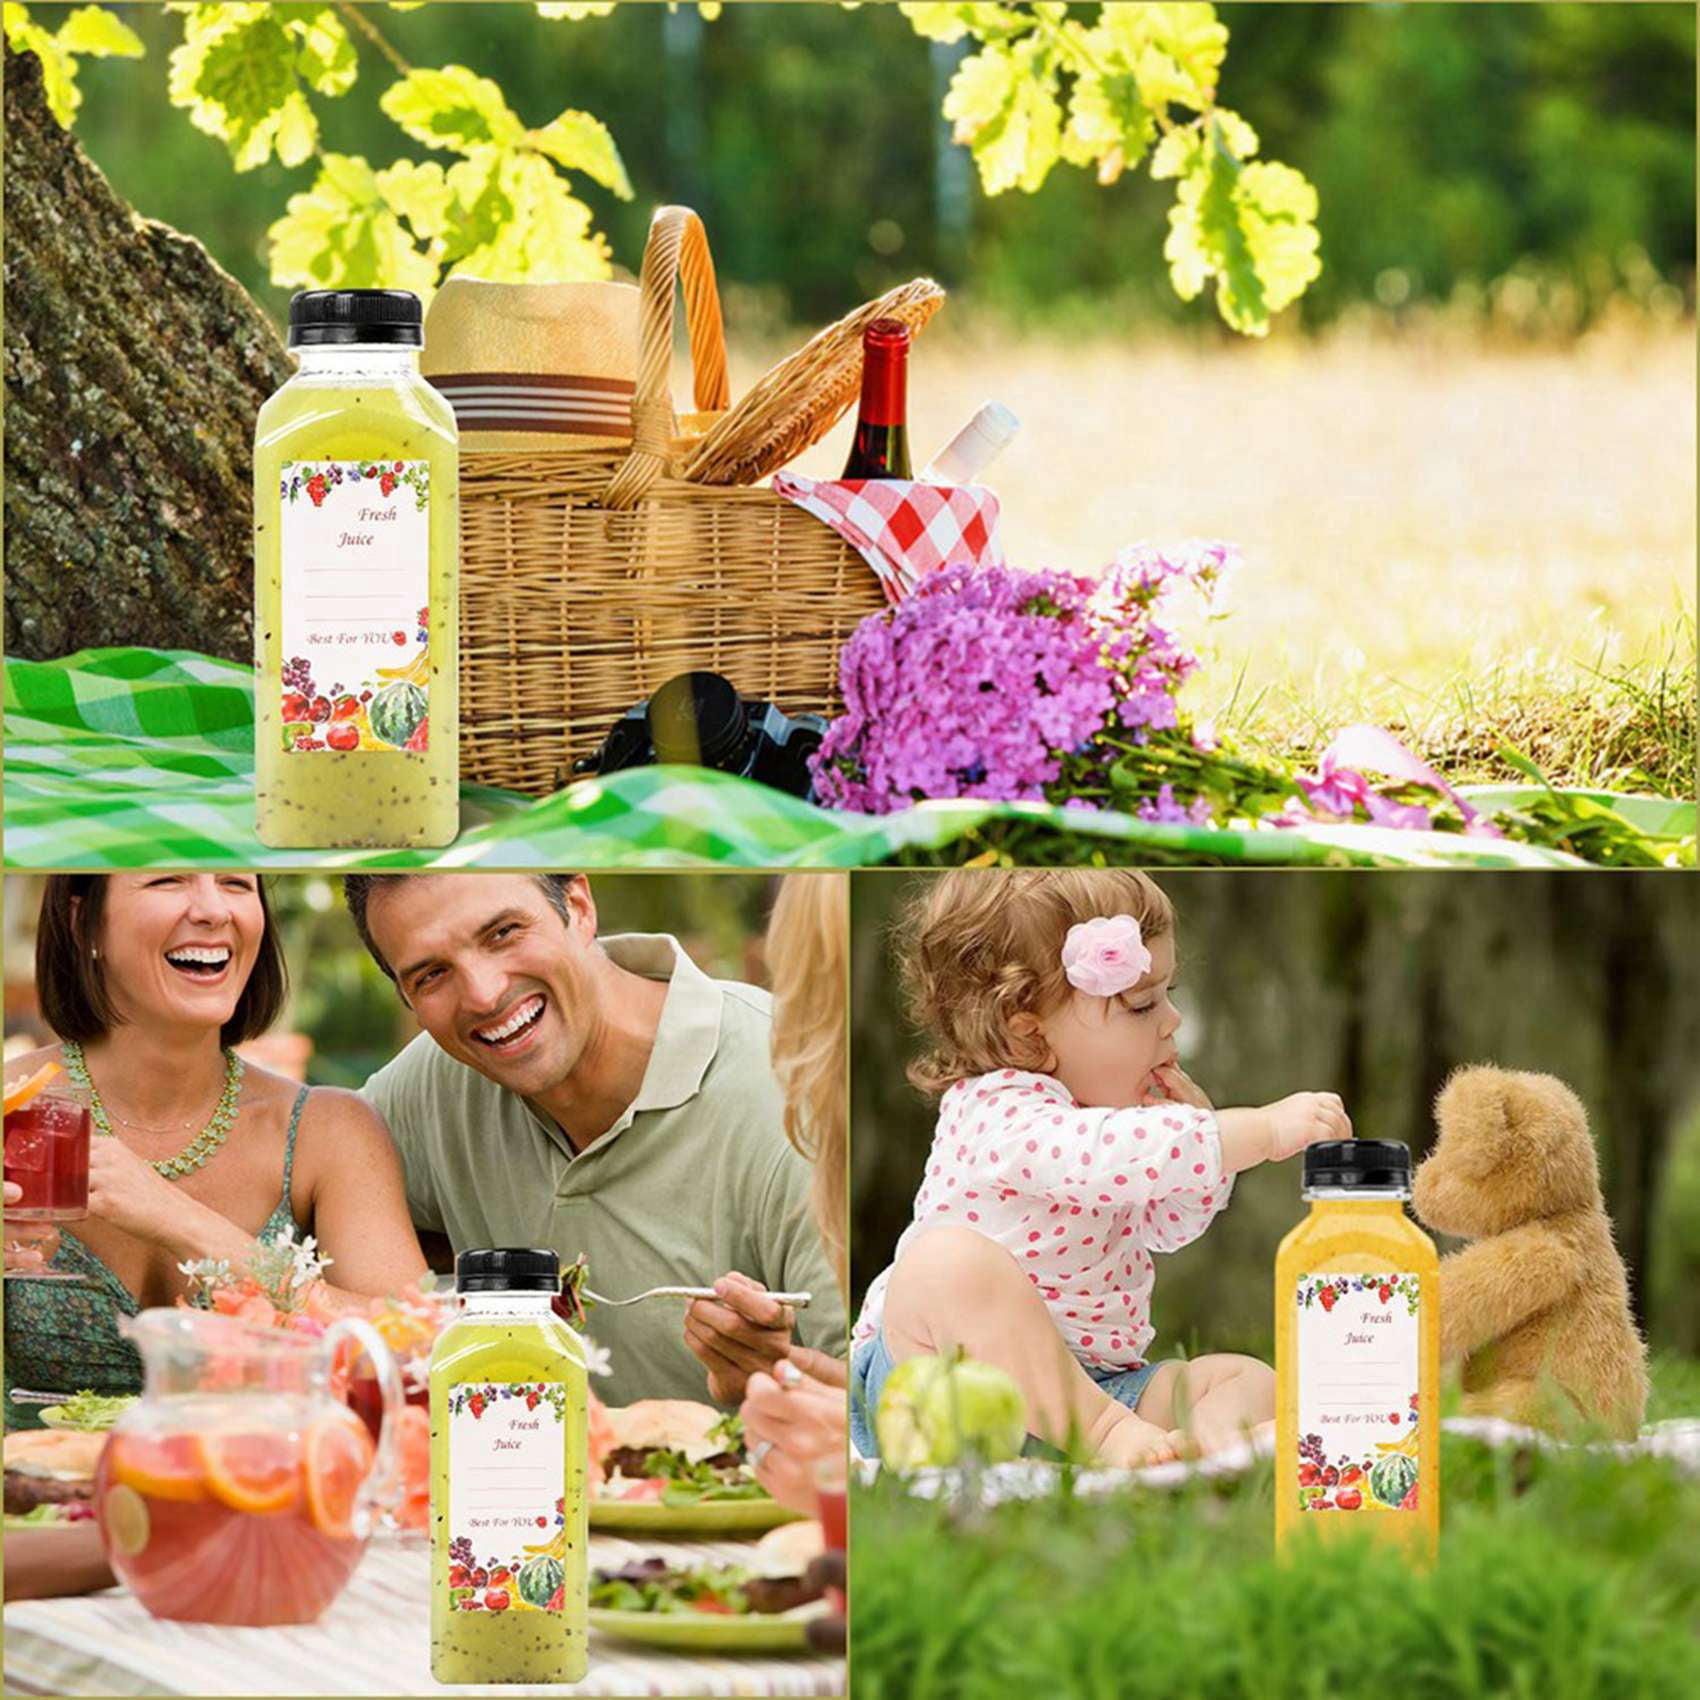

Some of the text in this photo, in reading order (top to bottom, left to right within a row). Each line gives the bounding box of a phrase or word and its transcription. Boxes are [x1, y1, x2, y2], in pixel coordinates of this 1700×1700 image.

[358, 505, 397, 522] Fresh
[337, 531, 375, 548] Juice
[306, 632, 333, 645] Best
[337, 632, 358, 645] For
[1360, 1310, 1393, 1324] Fresh
[1343, 1331, 1375, 1345] Juice
[508, 1418, 540, 1431] Fresh
[492, 1438, 522, 1452] Juice
